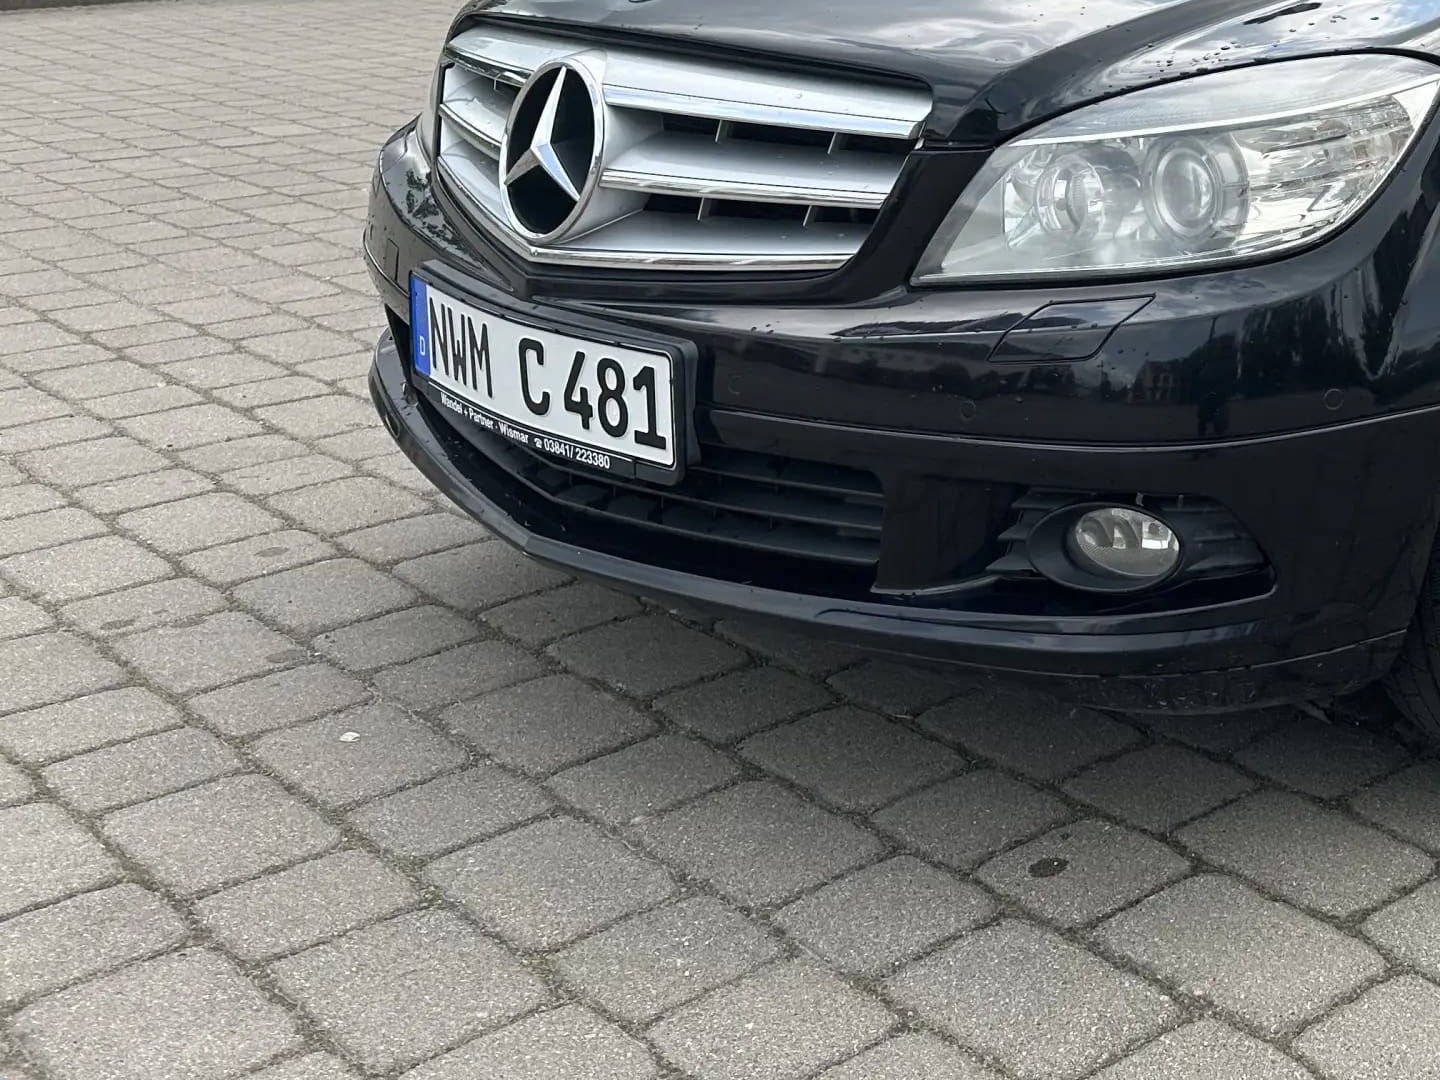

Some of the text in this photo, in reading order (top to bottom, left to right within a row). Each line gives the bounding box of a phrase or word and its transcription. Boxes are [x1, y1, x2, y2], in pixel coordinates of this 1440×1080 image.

[419, 335, 425, 356] D
[429, 297, 666, 450] NWM C 481
[440, 392, 463, 414] Wandel
[469, 408, 494, 430] Partner
[499, 422, 529, 444] Wismar
[576, 448, 611, 469] 223380
